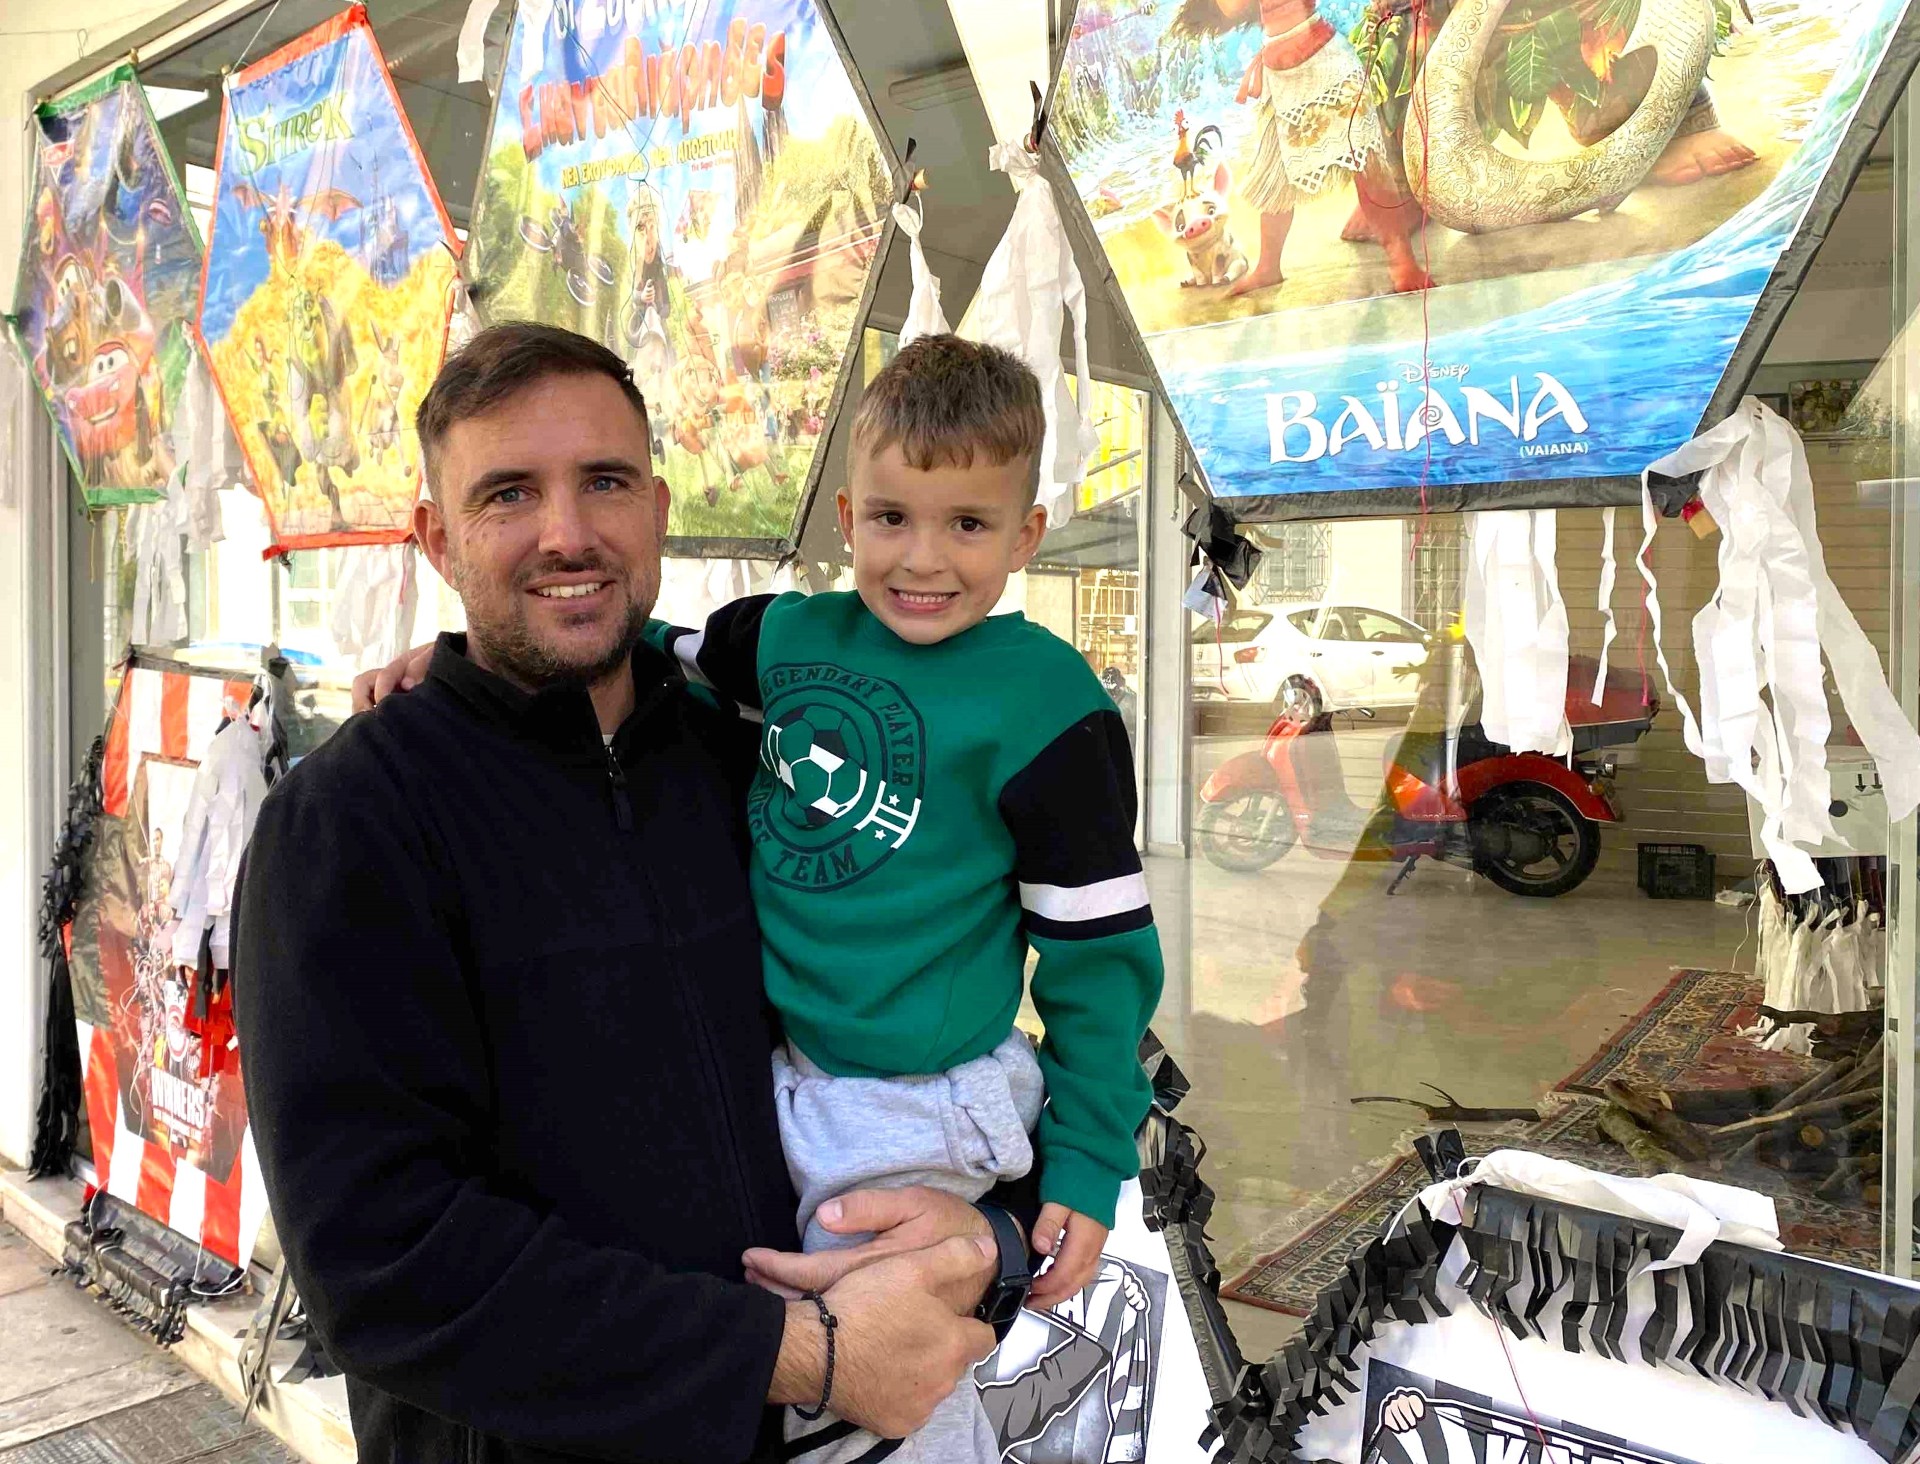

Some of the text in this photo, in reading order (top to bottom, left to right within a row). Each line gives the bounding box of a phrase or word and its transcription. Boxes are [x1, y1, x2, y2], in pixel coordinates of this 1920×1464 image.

[1519, 441, 1589, 458] (VAIANA)
[760, 667, 914, 787] EGENDARY PLAYER
[773, 843, 861, 885] TEAM
